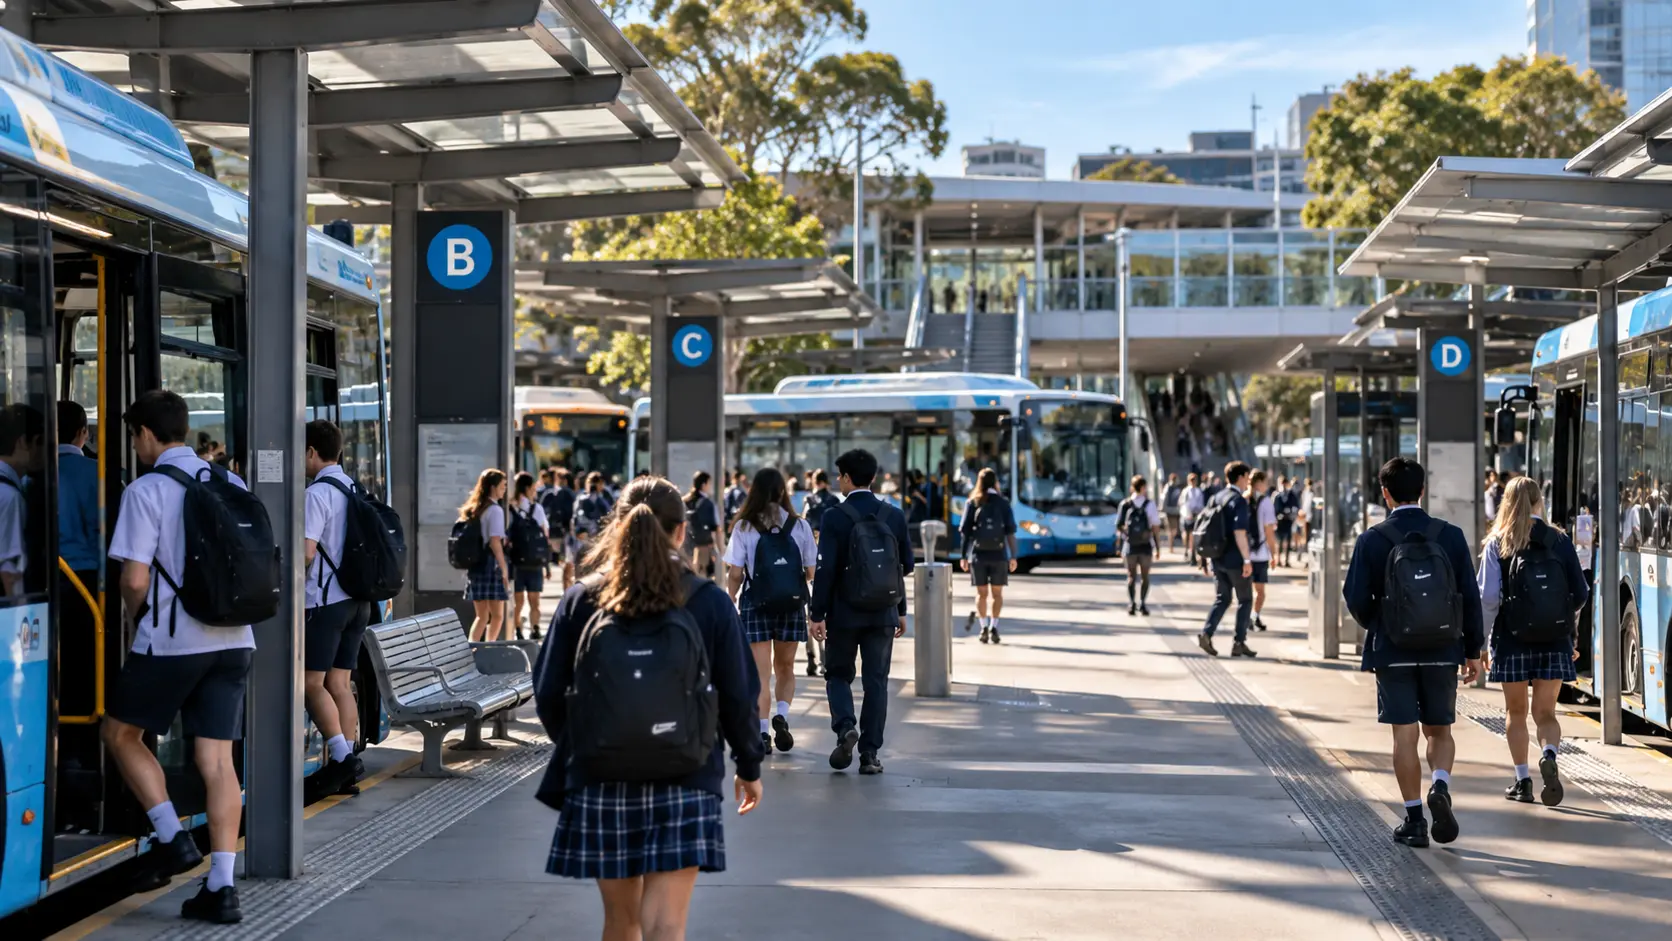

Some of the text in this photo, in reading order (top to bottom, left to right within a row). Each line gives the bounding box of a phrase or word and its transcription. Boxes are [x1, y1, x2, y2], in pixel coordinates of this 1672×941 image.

[447, 238, 475, 276] B
[681, 332, 703, 359] C
[1441, 343, 1462, 368] D
